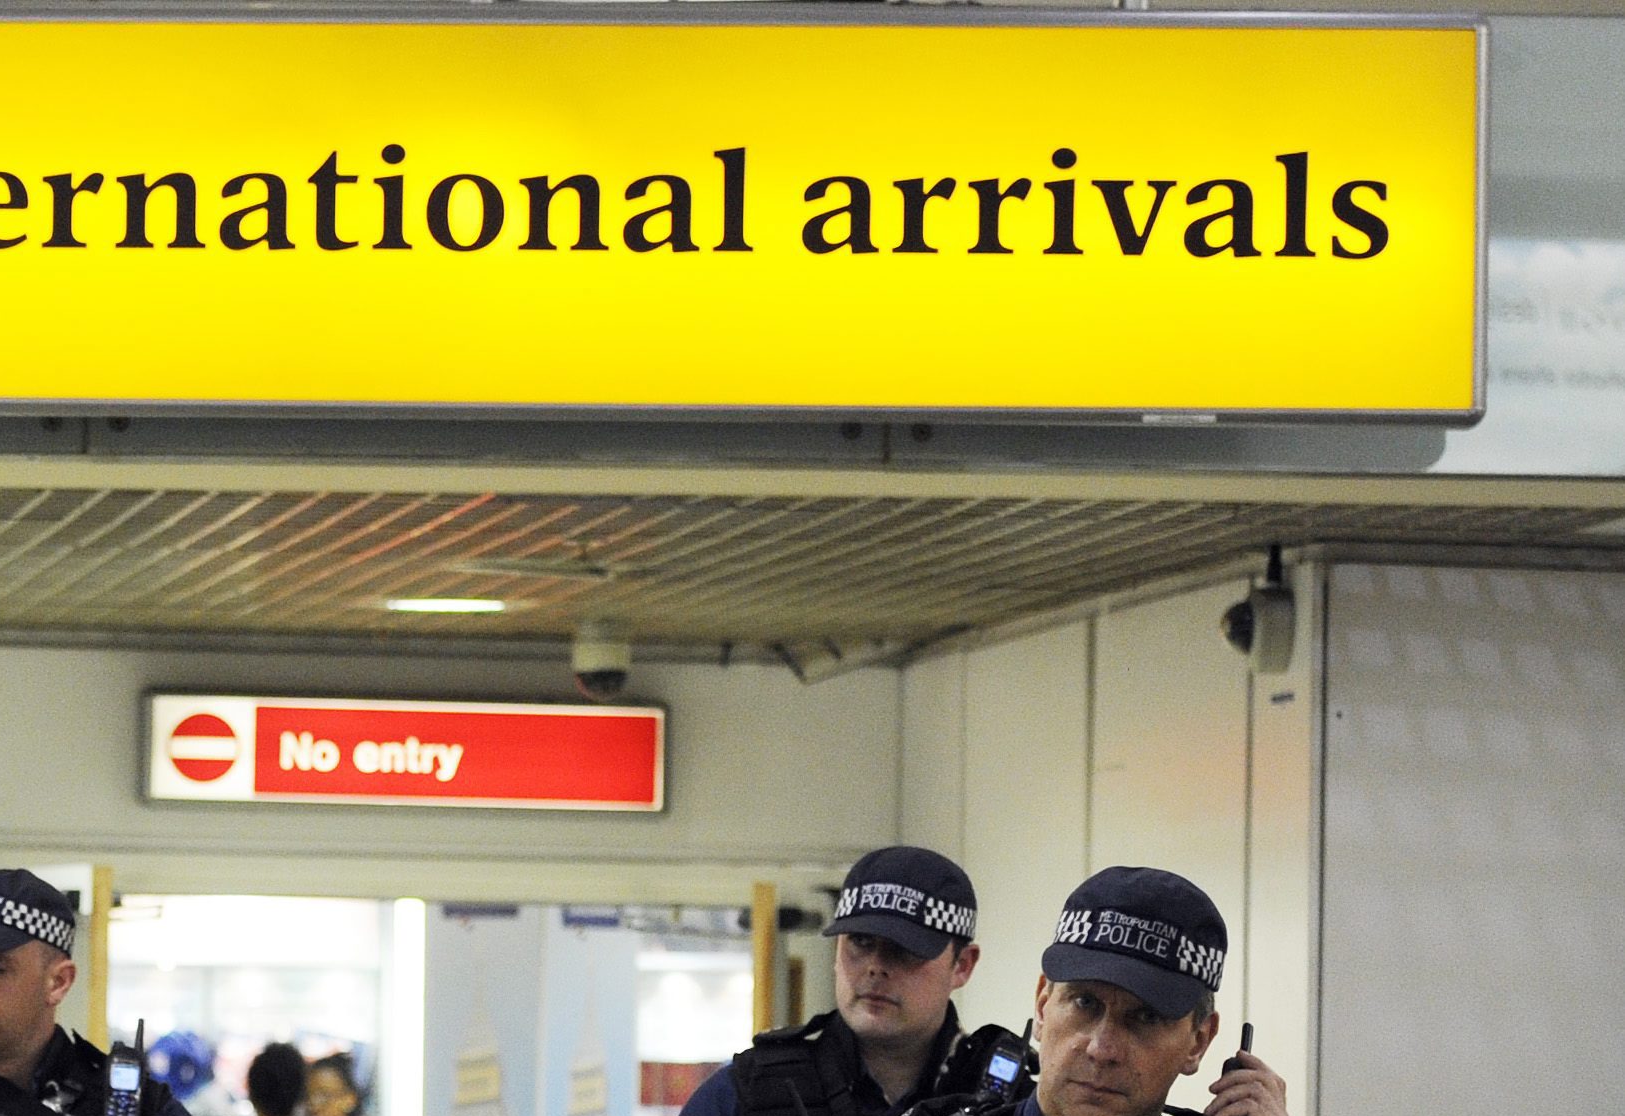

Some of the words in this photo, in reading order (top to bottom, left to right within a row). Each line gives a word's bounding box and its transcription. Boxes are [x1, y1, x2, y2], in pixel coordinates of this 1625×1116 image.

[801, 147, 1390, 260] arrivals
[278, 730, 341, 773] No
[352, 736, 464, 782] entry
[859, 893, 919, 916] POLICE
[1094, 923, 1170, 958] POLICE
[1099, 910, 1178, 940] METROPOLITAN
